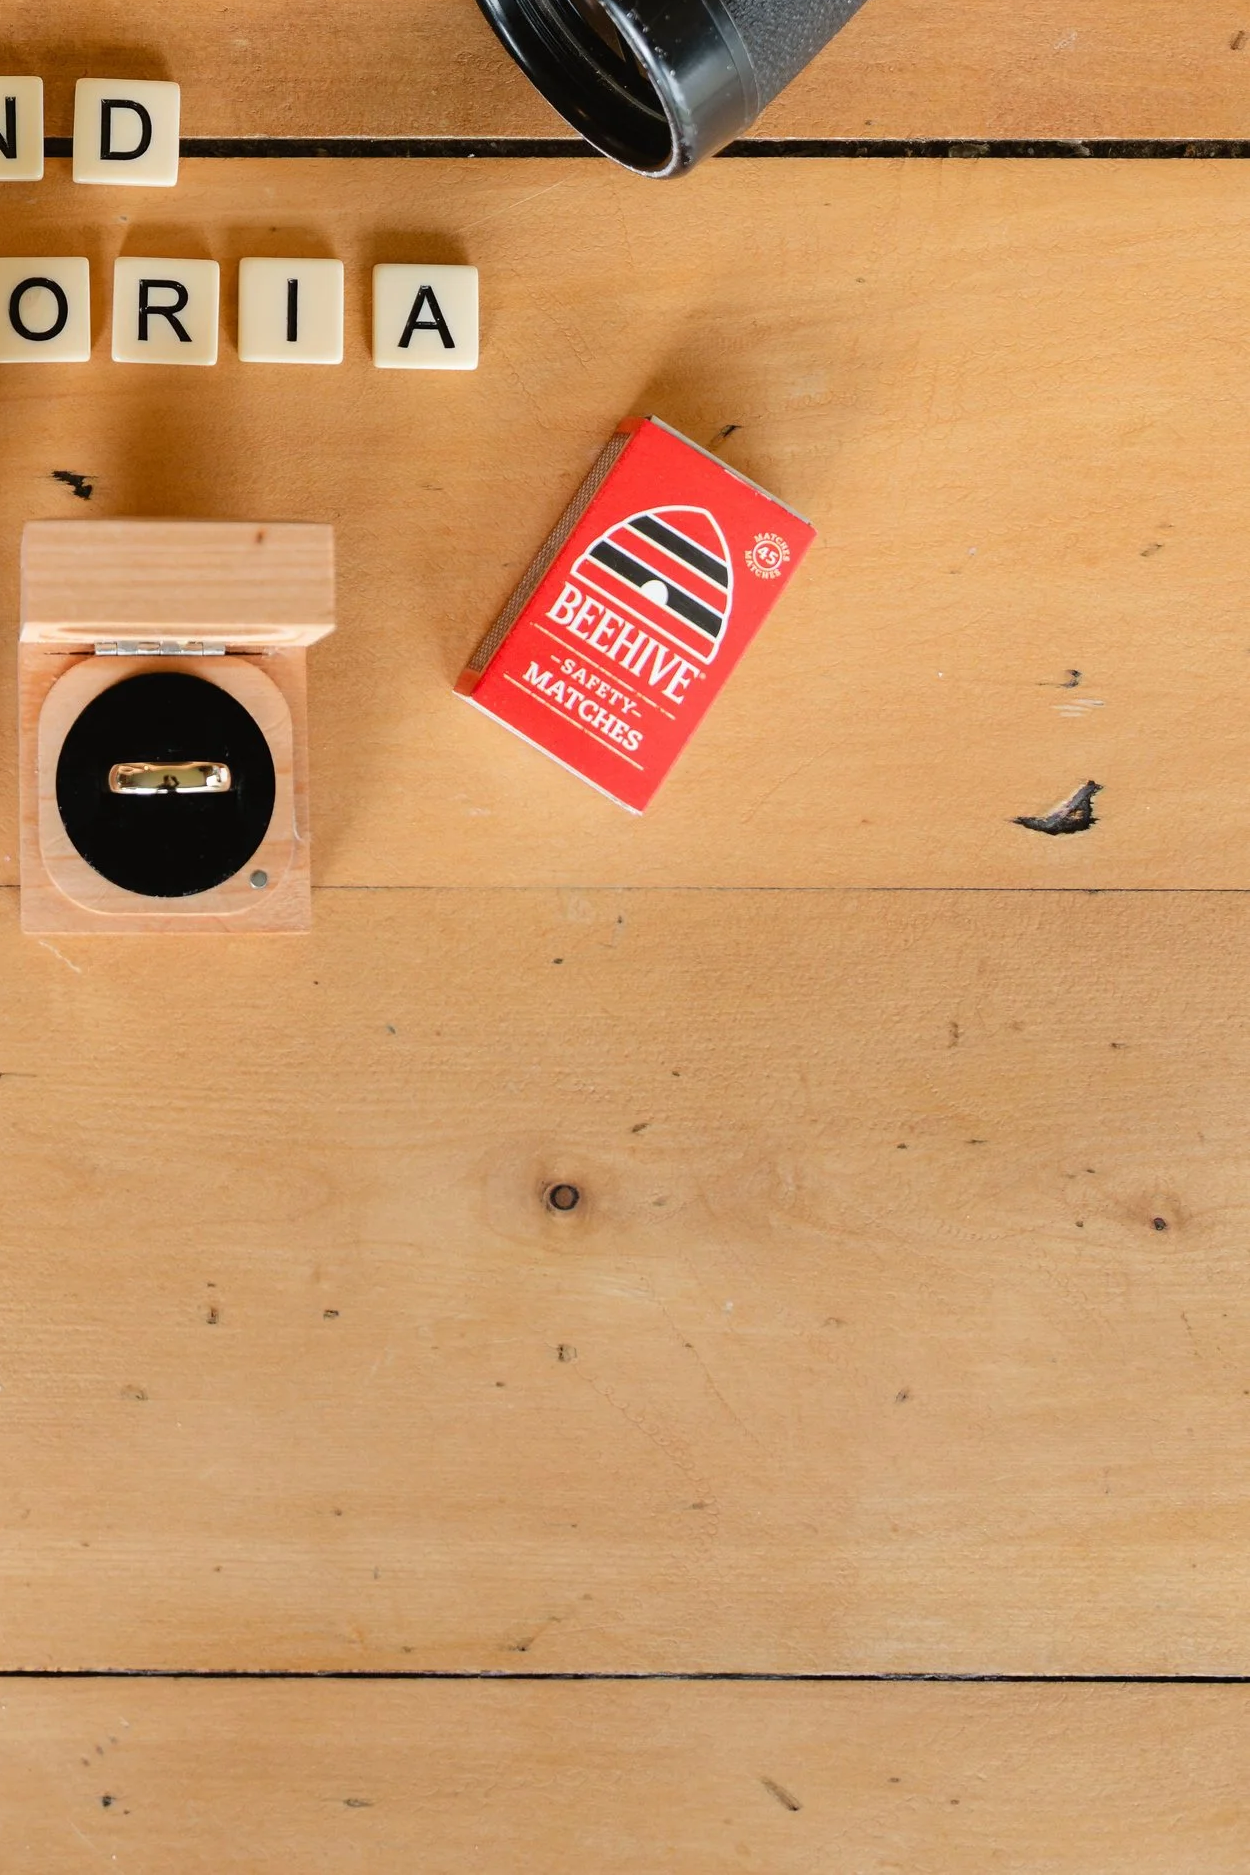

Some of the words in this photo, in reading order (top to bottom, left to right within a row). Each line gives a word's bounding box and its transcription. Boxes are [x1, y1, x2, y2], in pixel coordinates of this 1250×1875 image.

[753, 532, 791, 562] MATCHES
[757, 546, 779, 565] 45
[744, 550, 782, 580] MATCHES
[545, 581, 701, 705] BEEHIVE
[522, 661, 643, 751] MATCHES
